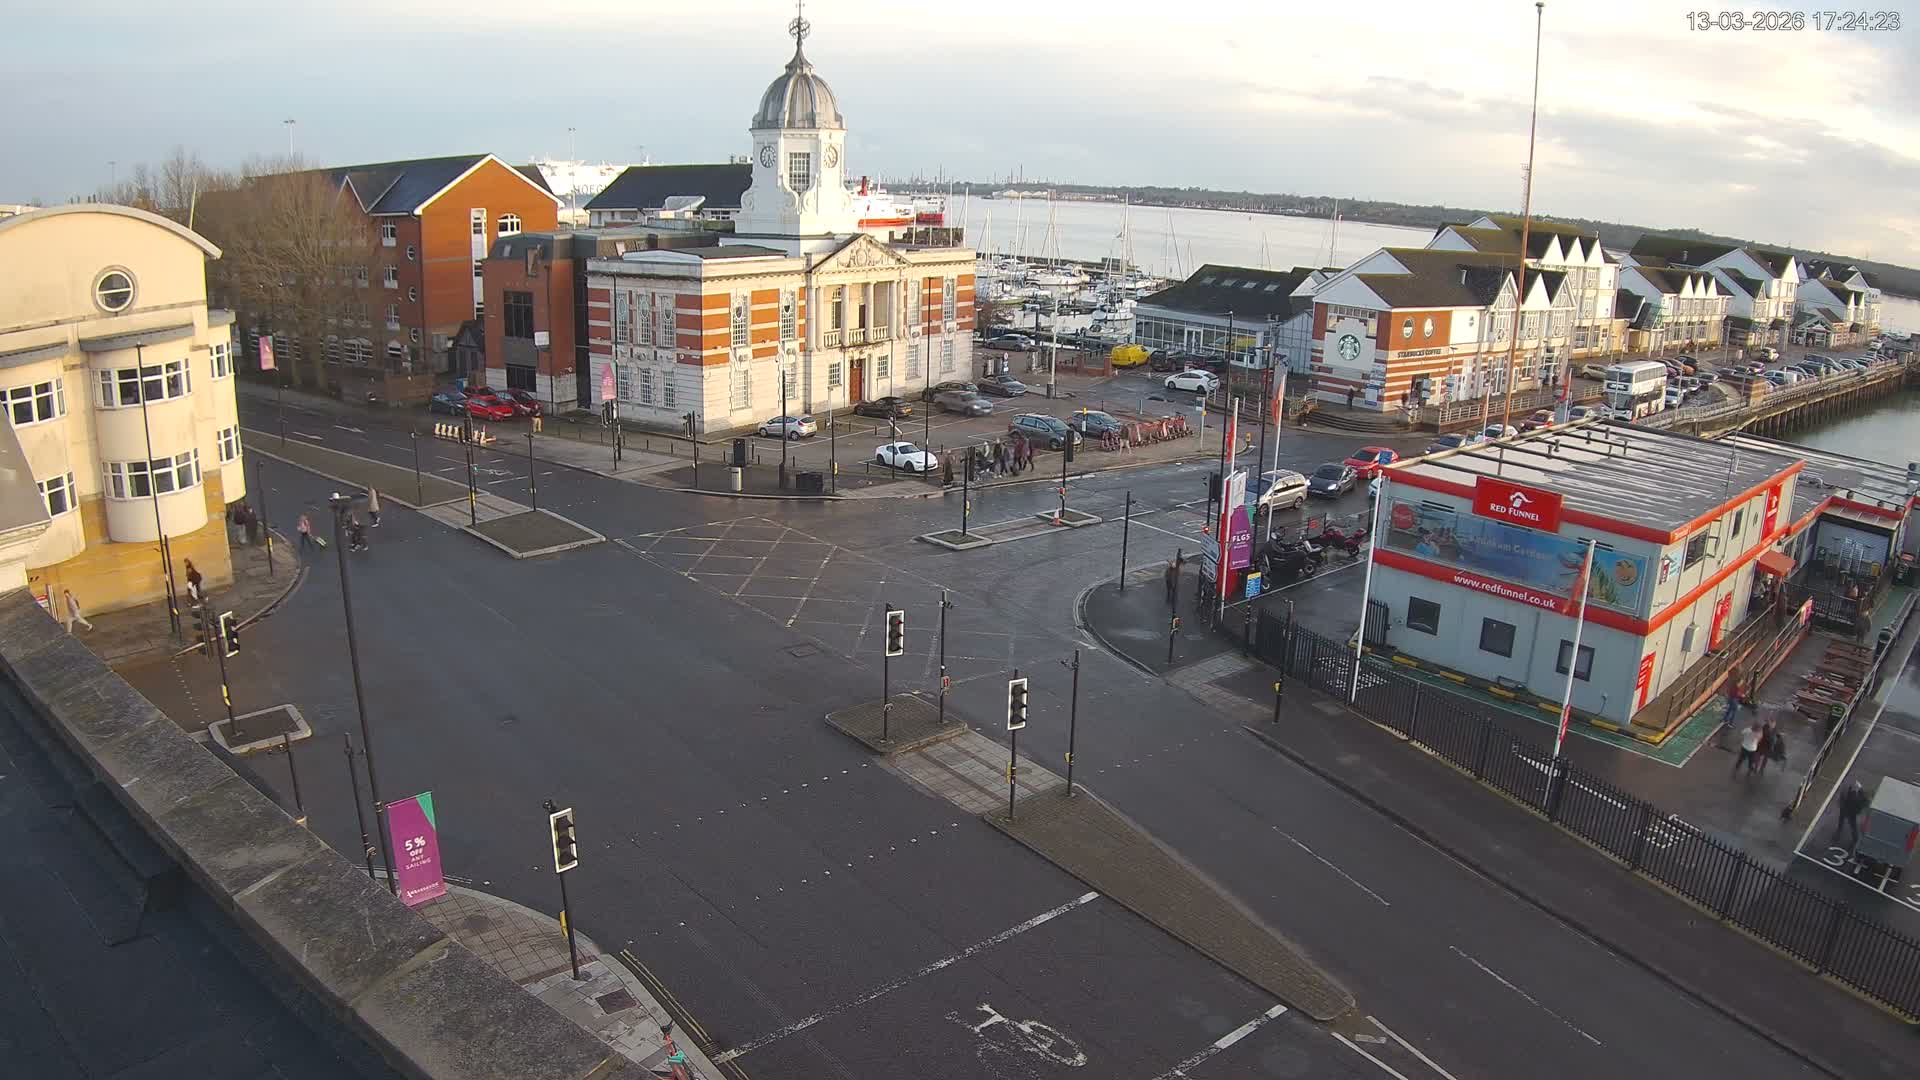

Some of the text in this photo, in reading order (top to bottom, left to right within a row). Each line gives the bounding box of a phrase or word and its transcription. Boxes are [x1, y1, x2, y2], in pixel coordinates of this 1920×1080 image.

[1490, 503, 1540, 521] RED FUNNEL
[1454, 575, 1555, 608] www.redfunnel.co.uk
[410, 848, 423, 857] OFF
[411, 854, 424, 862] ANY
[405, 857, 431, 870] SAILING
